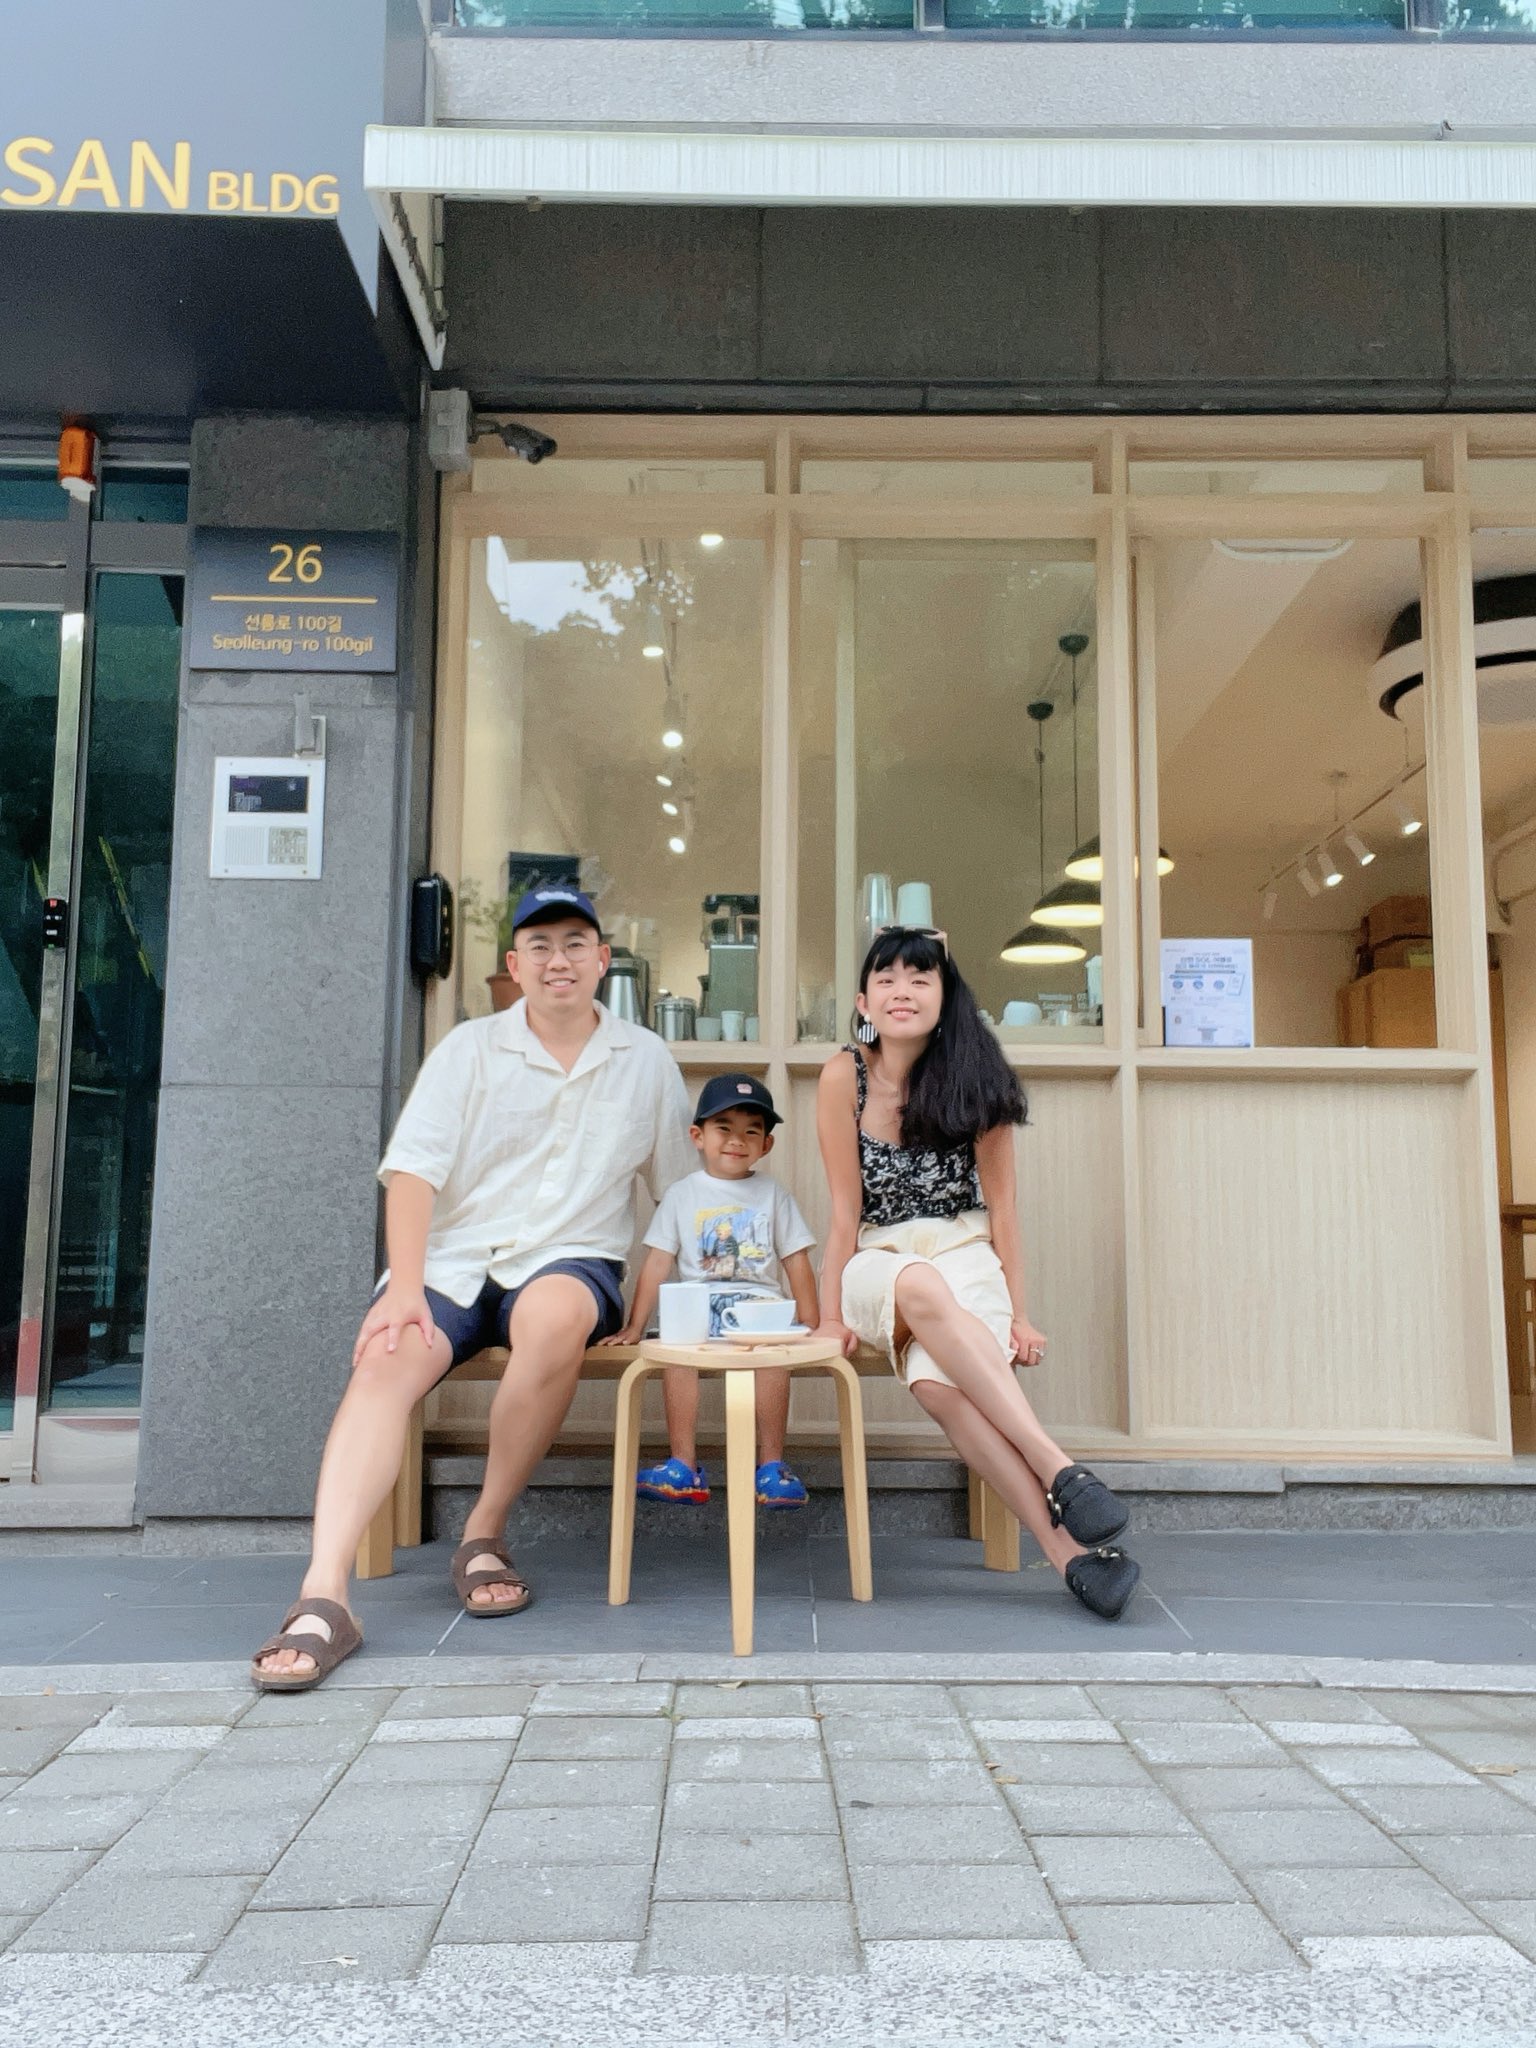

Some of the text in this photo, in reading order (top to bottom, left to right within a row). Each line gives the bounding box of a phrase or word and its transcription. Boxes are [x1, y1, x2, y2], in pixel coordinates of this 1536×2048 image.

[1, 136, 340, 214] SAN BLDG
[267, 543, 323, 583] 26
[298, 615, 342, 633] 100길
[212, 633, 374, 656] Seolleung-ro 100gil
